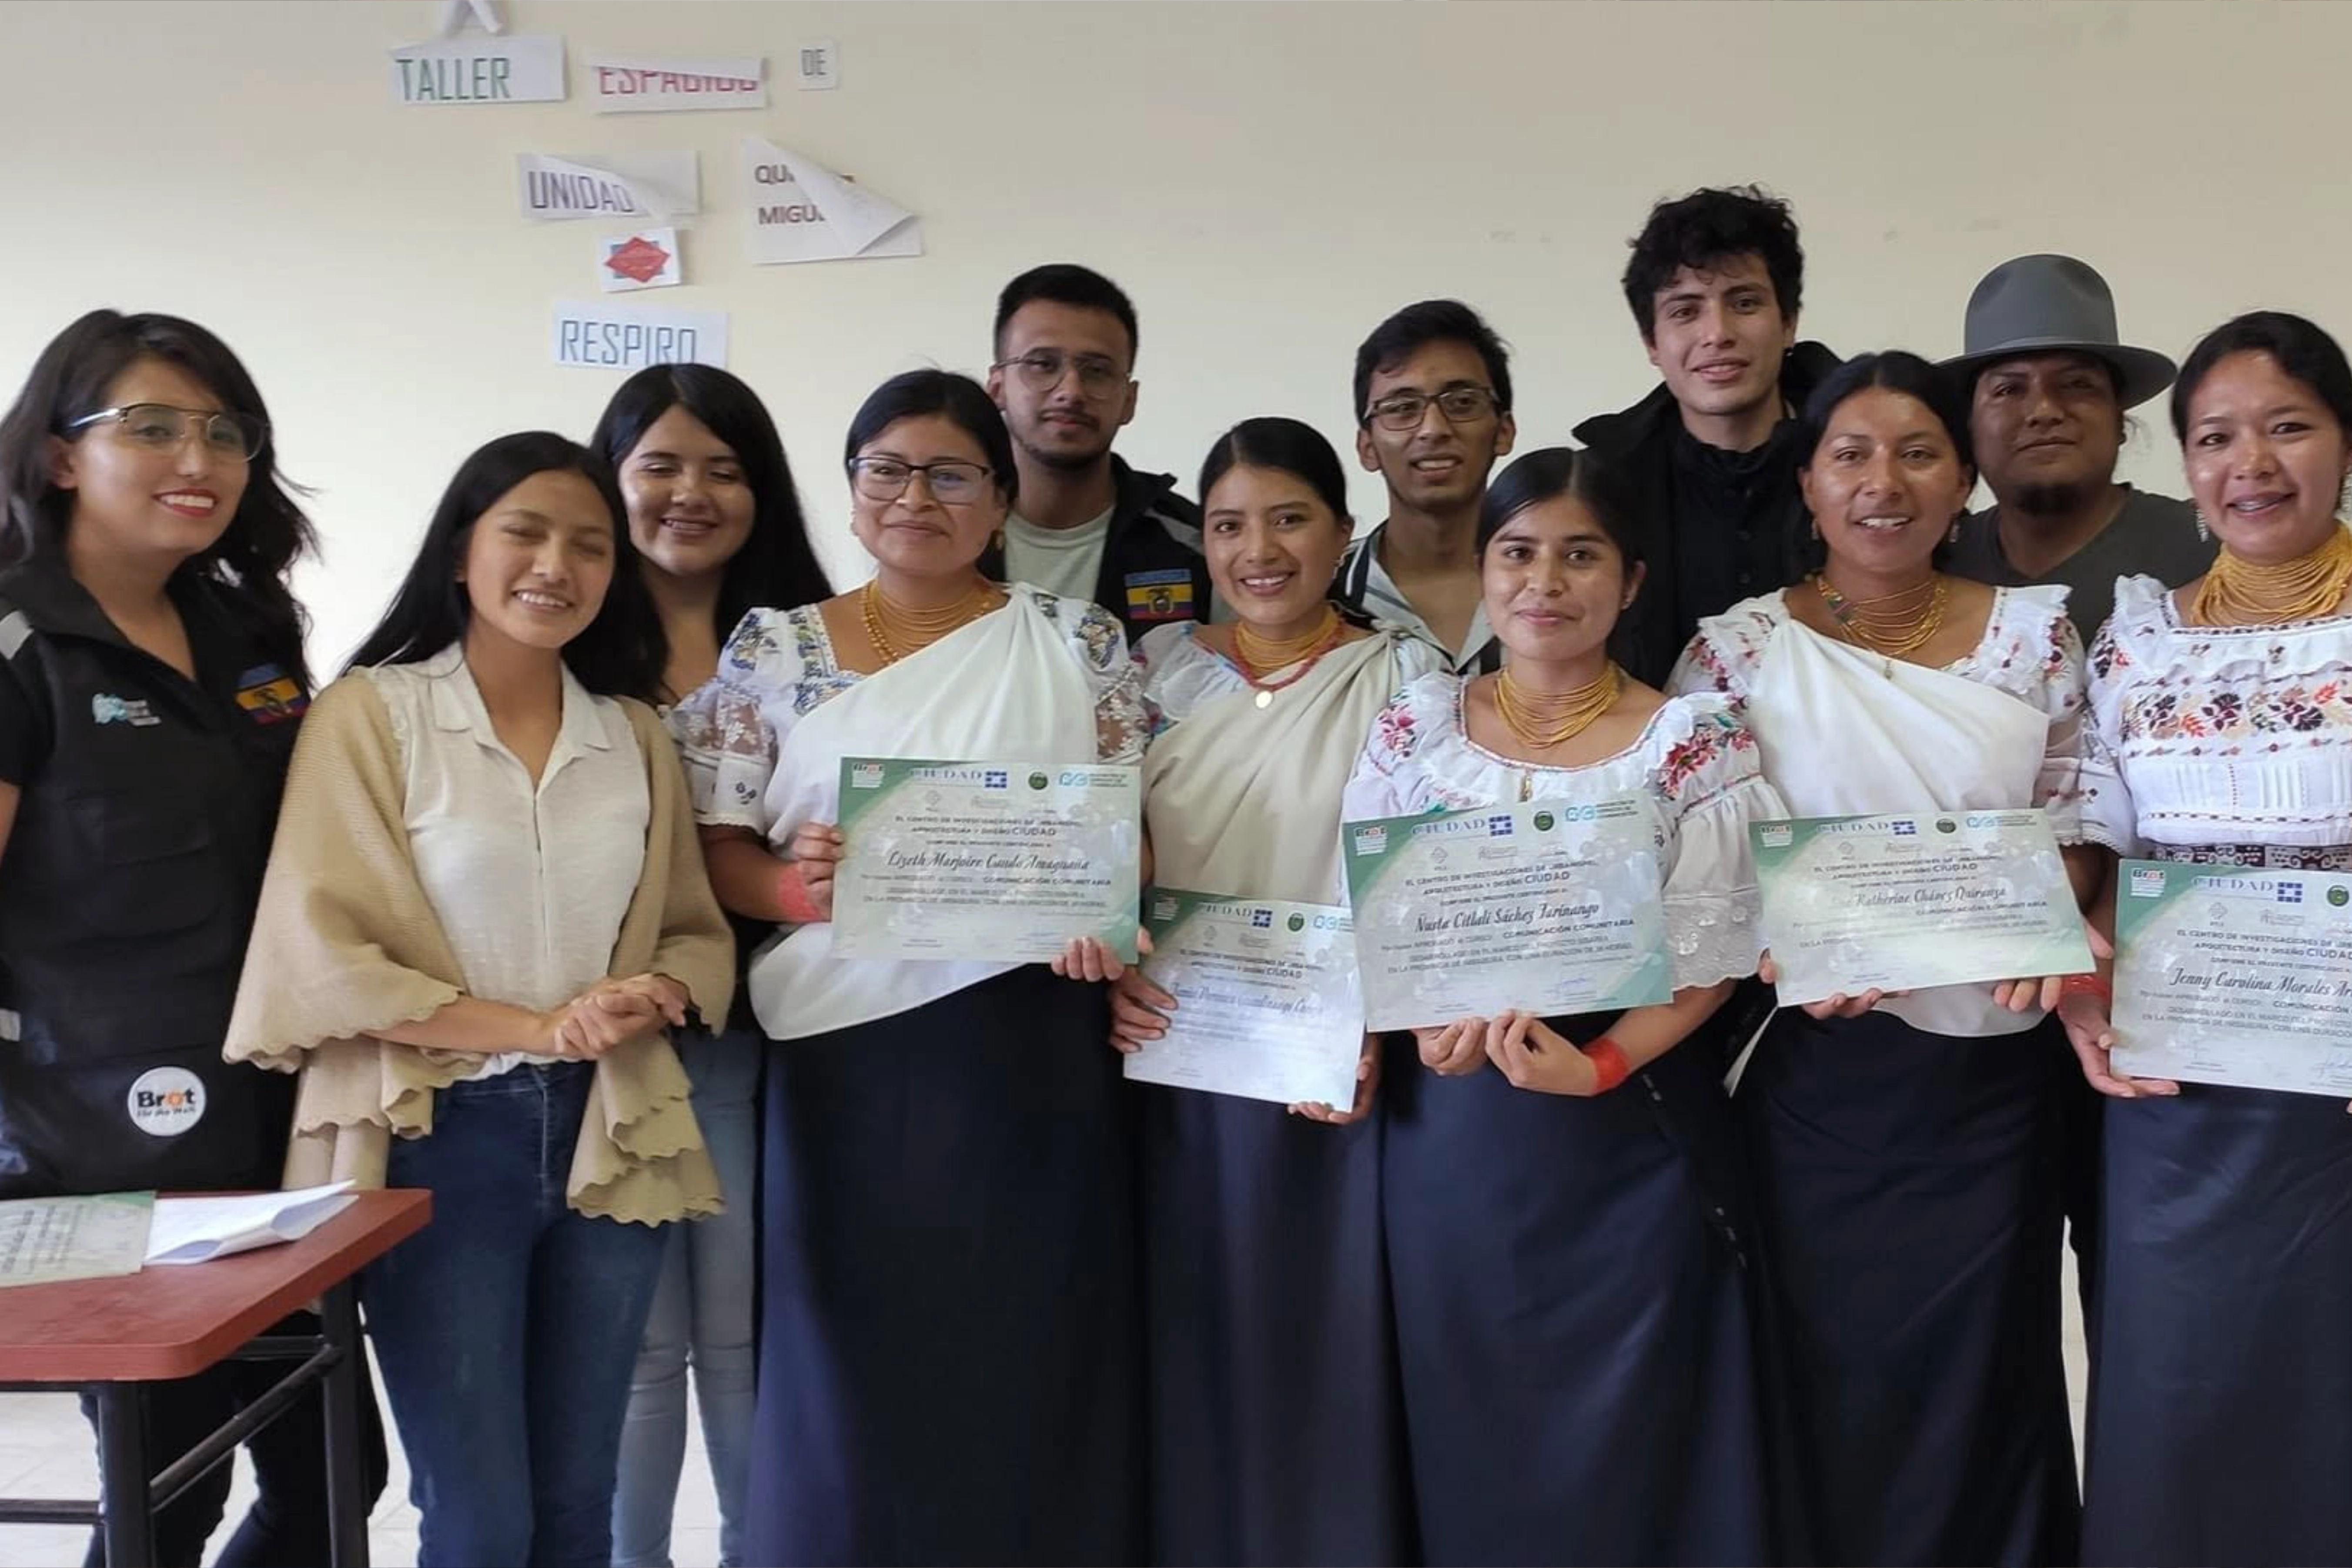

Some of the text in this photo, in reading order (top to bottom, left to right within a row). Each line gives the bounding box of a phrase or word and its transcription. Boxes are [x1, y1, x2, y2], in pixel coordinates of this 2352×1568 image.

[801, 49, 827, 76] DE
[395, 57, 510, 100] TALLER
[528, 171, 634, 213] UNIDAD
[561, 320, 697, 365] RESPIRO
[1012, 827, 1056, 836] CIUDAD
[887, 850, 926, 869] Lizeth
[1933, 863, 1978, 872] CIUDAD
[1525, 871, 1570, 884] CIUDAD
[2169, 967, 2212, 990] Jenny
[2215, 971, 2272, 990] Carolina
[2272, 975, 2332, 995] Morales
[137, 1087, 195, 1108] Brot
